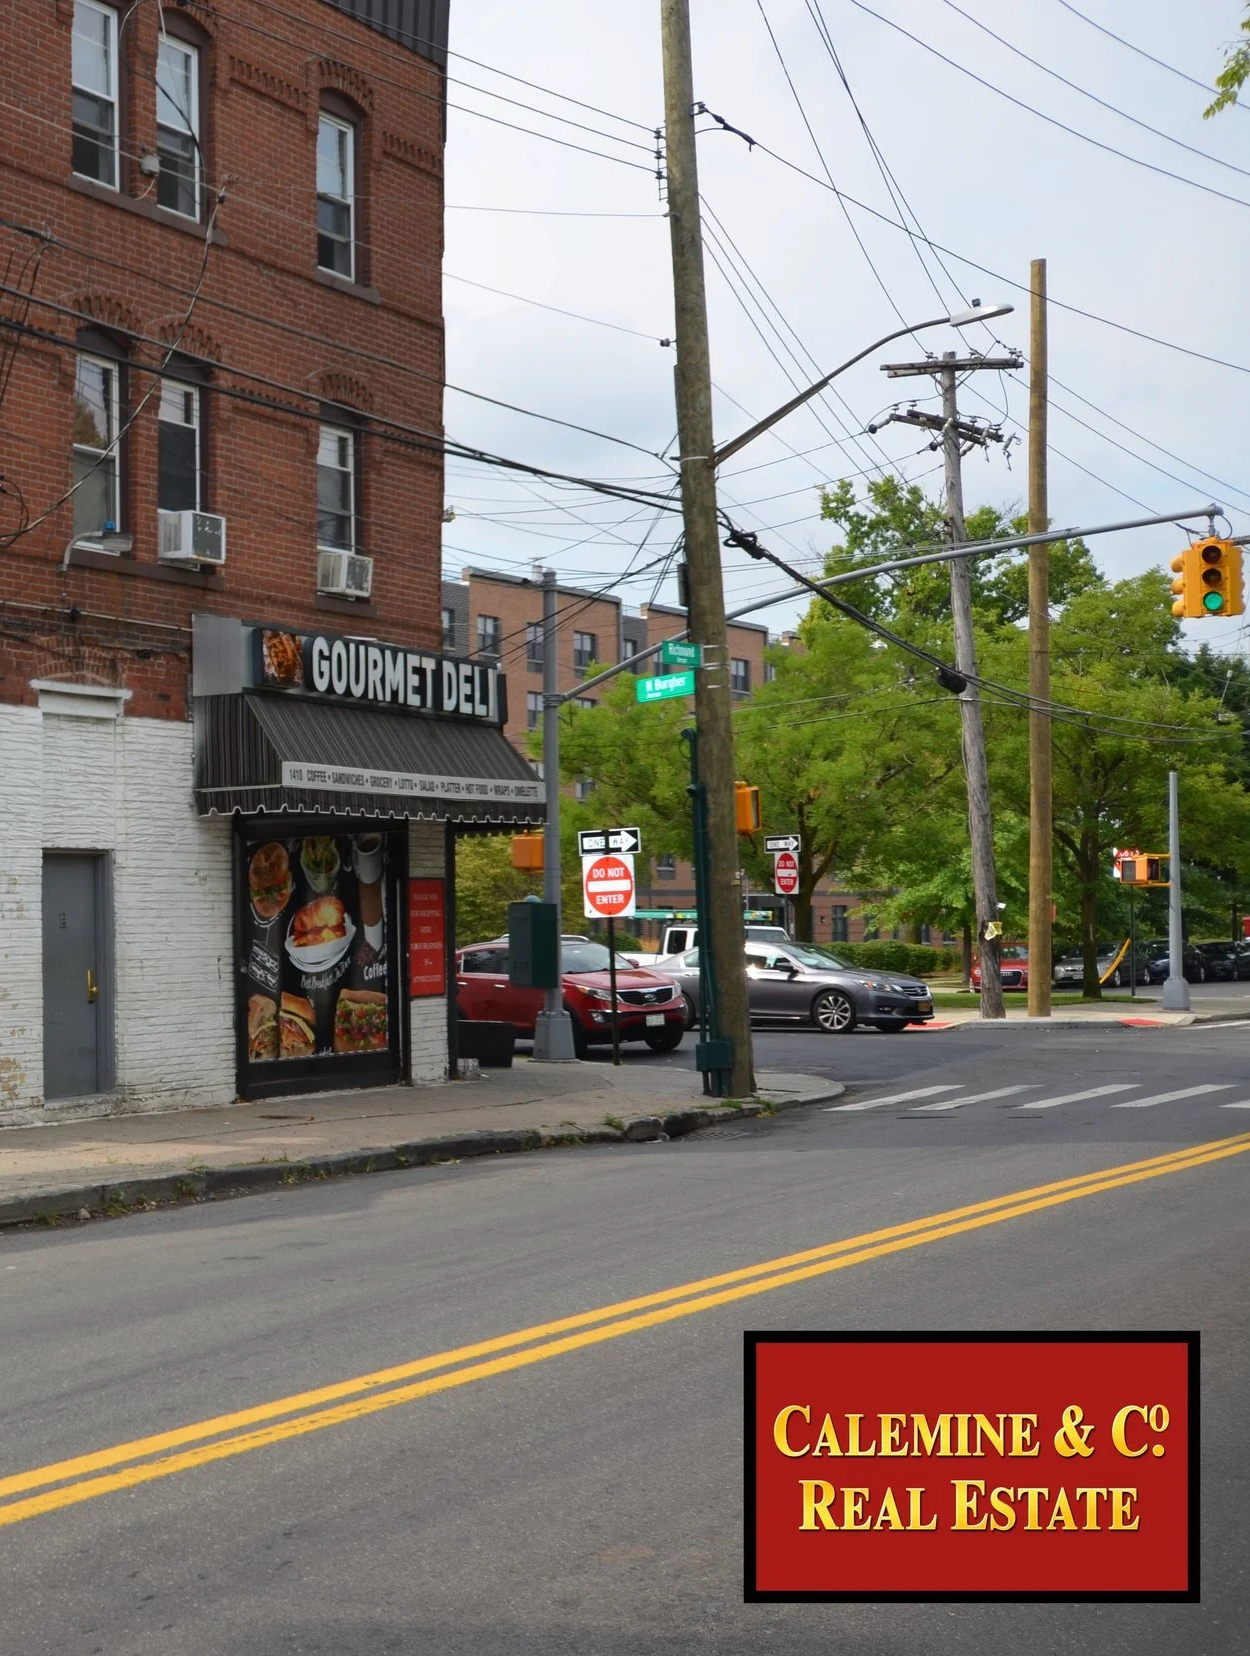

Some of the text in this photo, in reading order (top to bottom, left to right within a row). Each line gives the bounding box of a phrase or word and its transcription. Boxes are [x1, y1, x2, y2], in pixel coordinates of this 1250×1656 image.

[311, 635, 496, 717] GOURMET DELI
[307, 769, 327, 783] COFFEE
[331, 771, 365, 786] SANDWICHES
[370, 775, 393, 789] GROCERY
[398, 778, 414, 791] LOTTO
[419, 780, 435, 792] SALAD
[440, 781, 461, 794] PLATTER
[588, 838, 629, 848] ONE WAY
[778, 860, 795, 868] DO NOT
[592, 867, 625, 879] DO NOT
[780, 878, 794, 886] ENTER
[596, 894, 625, 905] ENTER
[363, 963, 388, 981] Coffee
